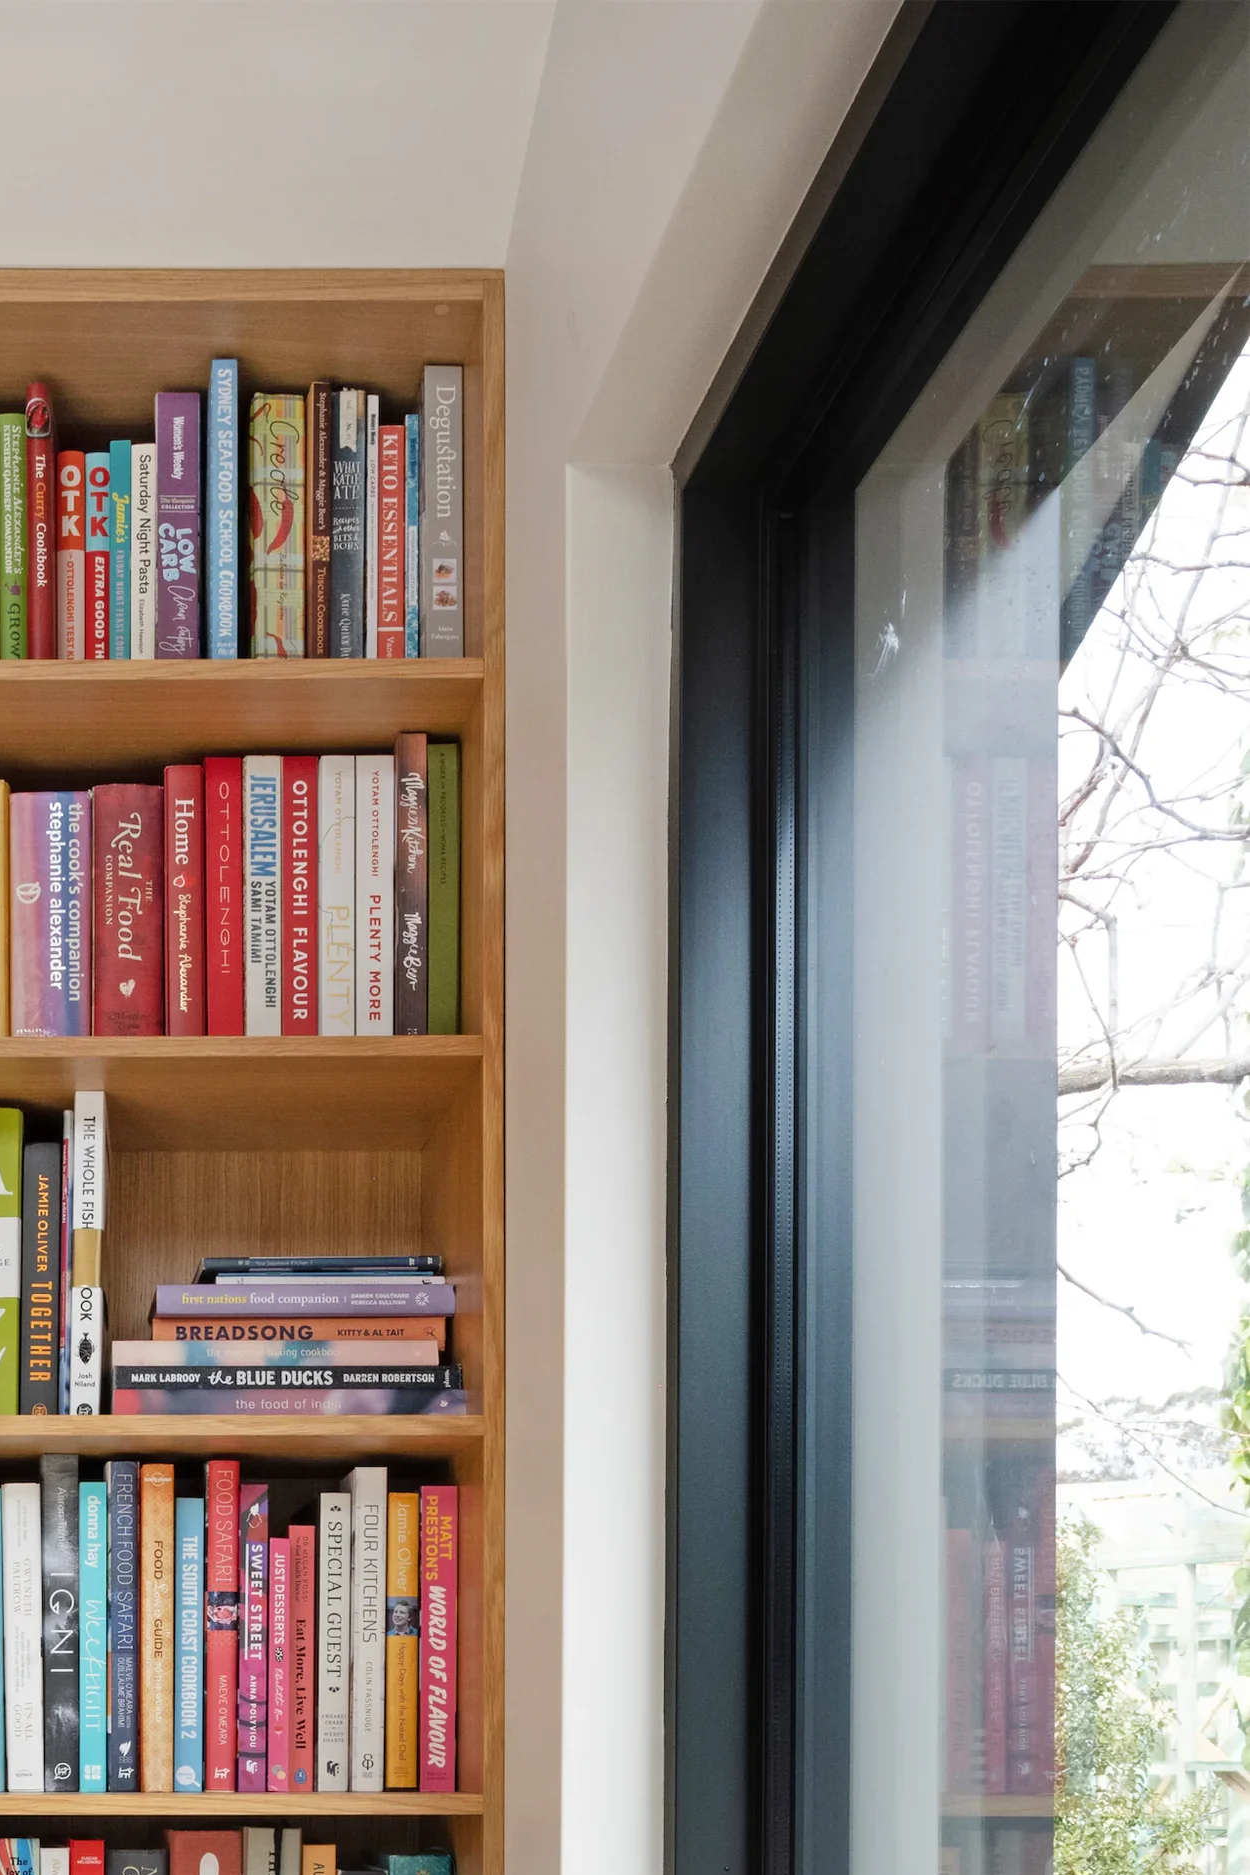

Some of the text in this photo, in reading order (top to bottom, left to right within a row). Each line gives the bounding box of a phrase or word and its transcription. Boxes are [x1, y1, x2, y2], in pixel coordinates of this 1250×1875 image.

[217, 369, 234, 425] SYDNEY
[137, 455, 151, 513] Saturday
[171, 417, 184, 480] Women's Weekly
[217, 430, 233, 503] SEAFOOD
[269, 420, 300, 516] Creole
[430, 385, 457, 518] Degustation
[33, 454, 47, 587] The Curry Cookbook
[137, 518, 151, 555] Night
[159, 523, 179, 582] CARB
[177, 528, 196, 574] LOW
[219, 510, 233, 566] SCHOOL
[382, 434, 398, 622] KETO ESSENTIALS
[139, 559, 151, 594] Pasta
[219, 570, 233, 637] COOKBOOK
[46, 802, 65, 989] stephanie alexander
[65, 803, 84, 1001] the cook's companion
[105, 855, 113, 925] COMPANION
[111, 812, 142, 961] Real Food
[172, 798, 194, 950] Home Stephanie
[219, 782, 230, 973] OTTOLENGHI
[250, 775, 276, 1008] JERUSALEM YOTAM OTTOLENGHI
[292, 780, 308, 1020] OTTOLENGHI FLAVOUR
[370, 895, 381, 963] PLENTY
[327, 905, 350, 1027] PLENTY
[369, 971, 381, 1021] MORE
[83, 1145, 94, 1196] WHOLE
[29, 1174, 53, 1381] JAMIE OLIVER TOGETHER
[182, 1293, 339, 1306] first nations food companion
[176, 1325, 405, 1341] BREADSONG KITTY TAIT
[131, 1369, 435, 1386] MARK LABROOY the BLUE DUCKS DARREN ROBERTSON
[235, 1399, 307, 1409] the food of
[84, 1495, 101, 1568] donna hay
[117, 1474, 134, 1650] FRENCH FOOD SAFARI
[154, 1540, 163, 1579] FOOD
[362, 1504, 379, 1551] FOUR
[397, 1502, 411, 1592] Jamie Oliver
[425, 1495, 438, 1580] PRESTON'S
[440, 1516, 452, 1560] MATT
[49, 1573, 74, 1673] IGNI
[216, 1470, 233, 1704] FOOD SAFARI MAEVE
[274, 1552, 285, 1644] JUST DESSERTS
[327, 1521, 342, 1678] SPECIAL GUEST
[362, 1558, 378, 1643] KITCHENS
[428, 1586, 447, 1650] WORLD
[179, 1536, 198, 1739] THE SOUTH COAST COOKBOOK 2
[249, 1544, 262, 1748] SWEET STREET ANNA POLYVIOU
[428, 1656, 446, 1679] OF
[295, 1619, 307, 1749] Eat Live Well
[364, 1688, 372, 1733] FASSNIDGE
[427, 1685, 447, 1768] FLAVOUR
[10, 1856, 28, 1866] The
